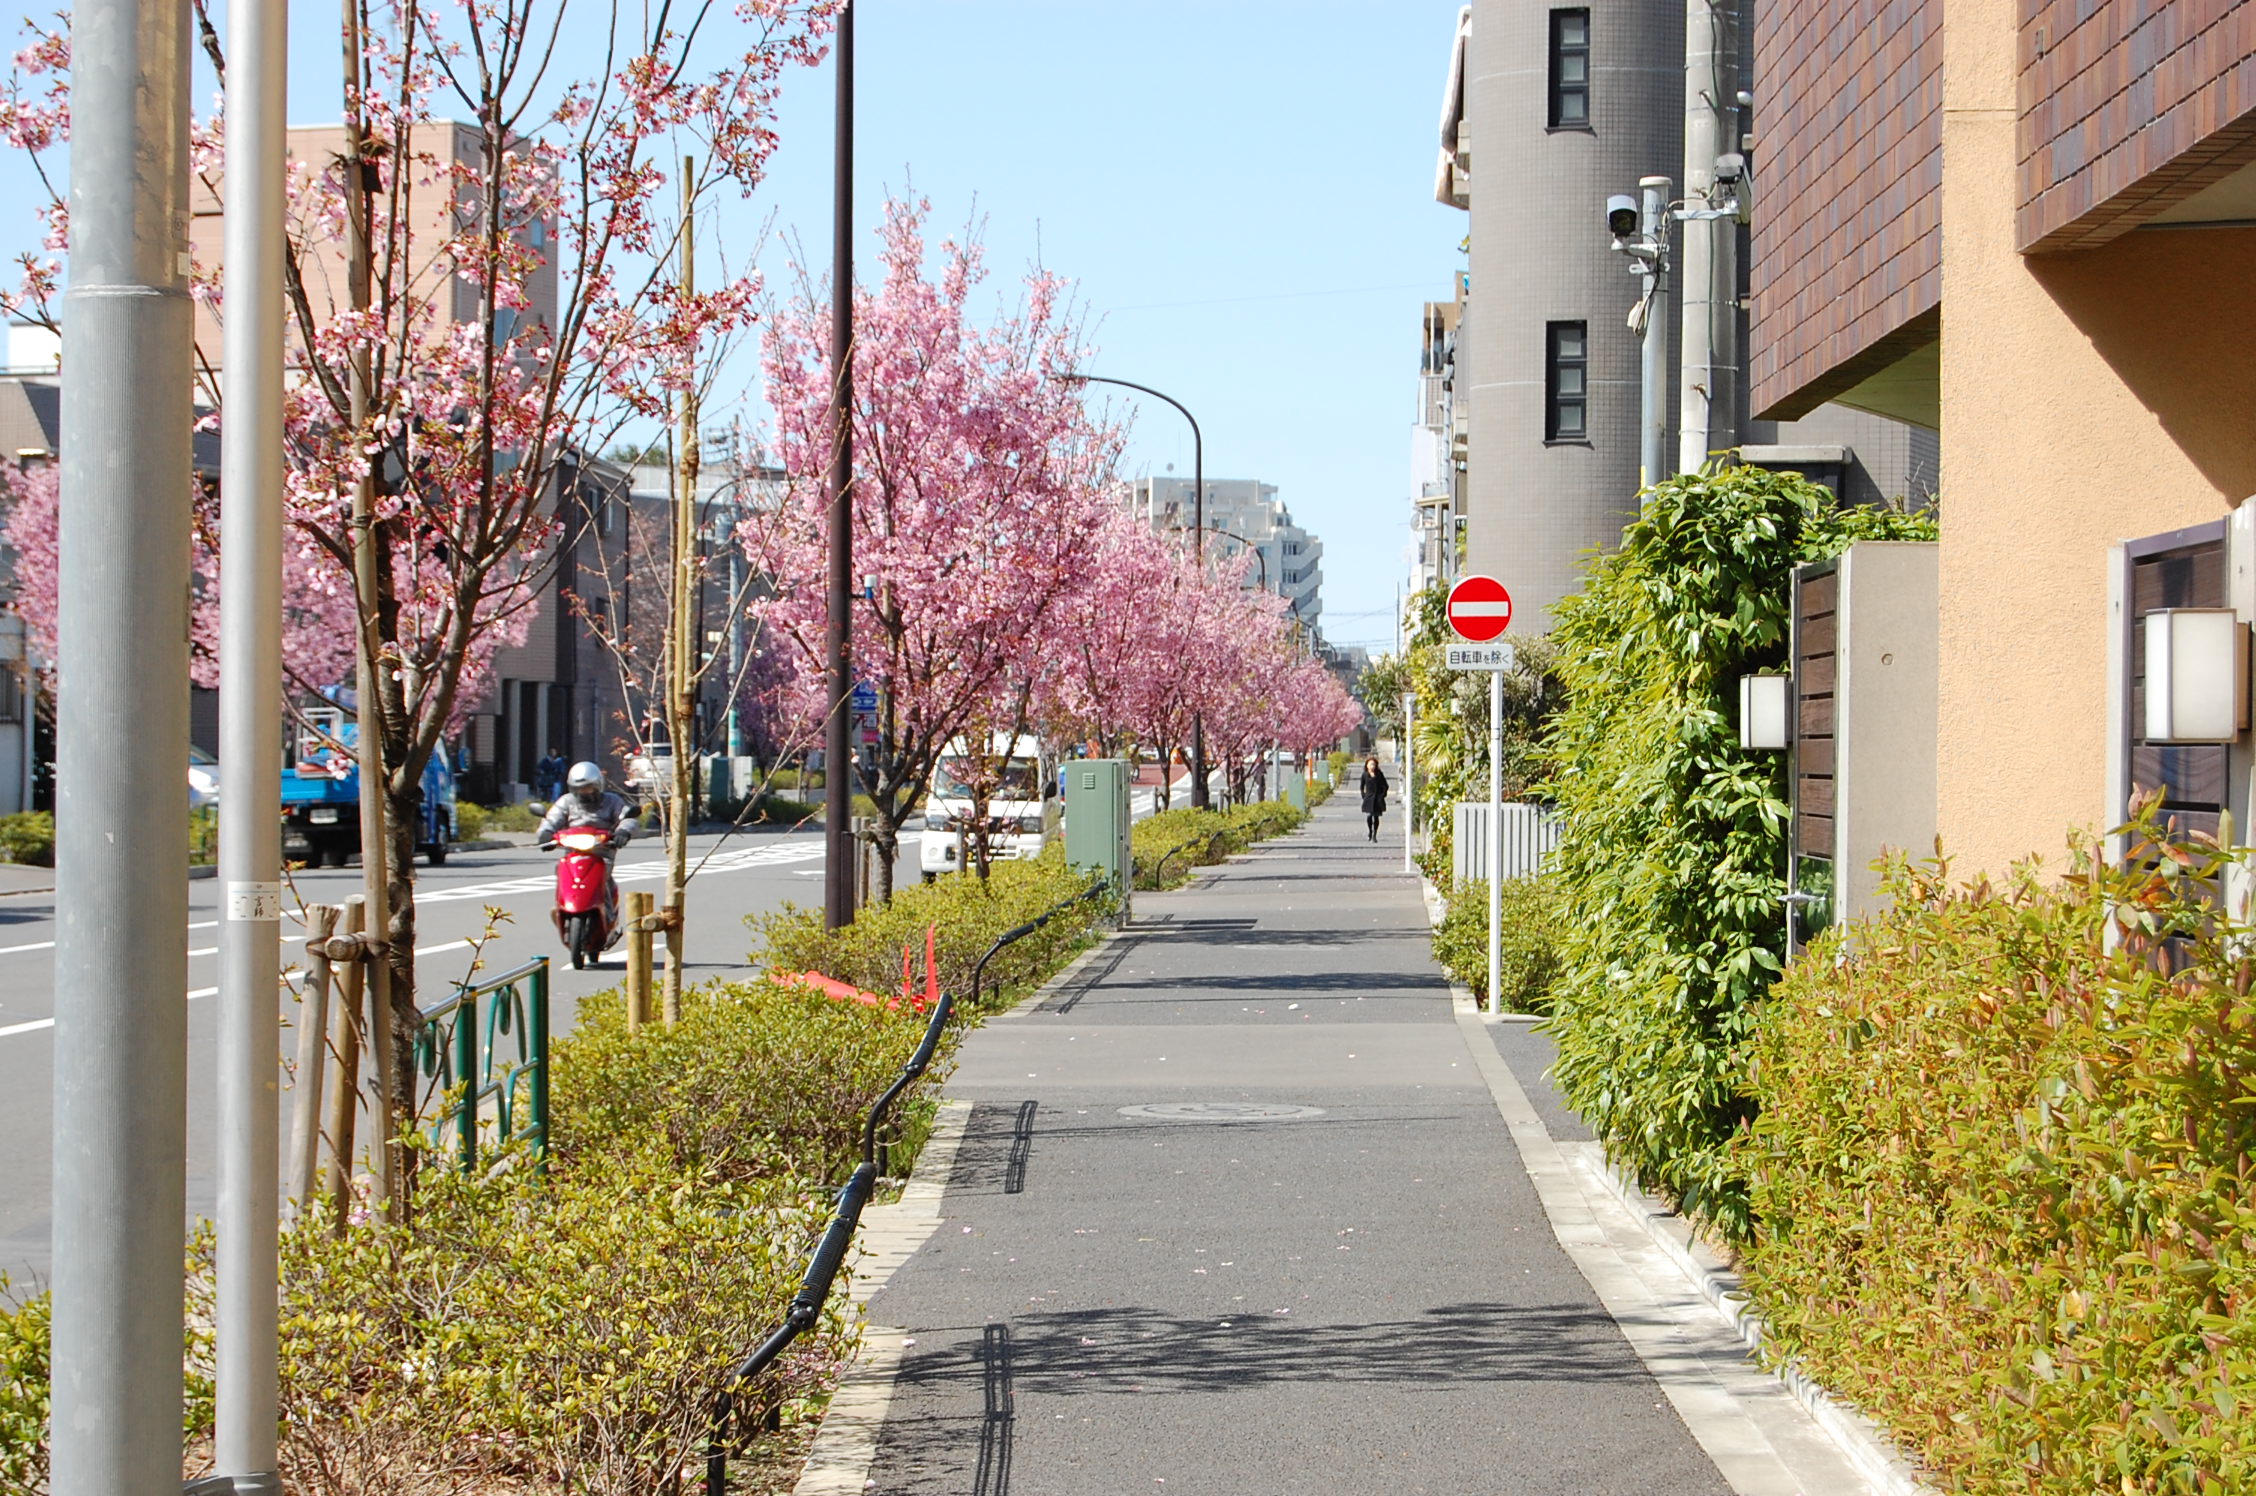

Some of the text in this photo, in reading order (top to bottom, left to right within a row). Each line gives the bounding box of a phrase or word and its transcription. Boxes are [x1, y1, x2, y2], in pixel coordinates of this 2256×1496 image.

[1450, 650, 1509, 664] 自転車を除く
